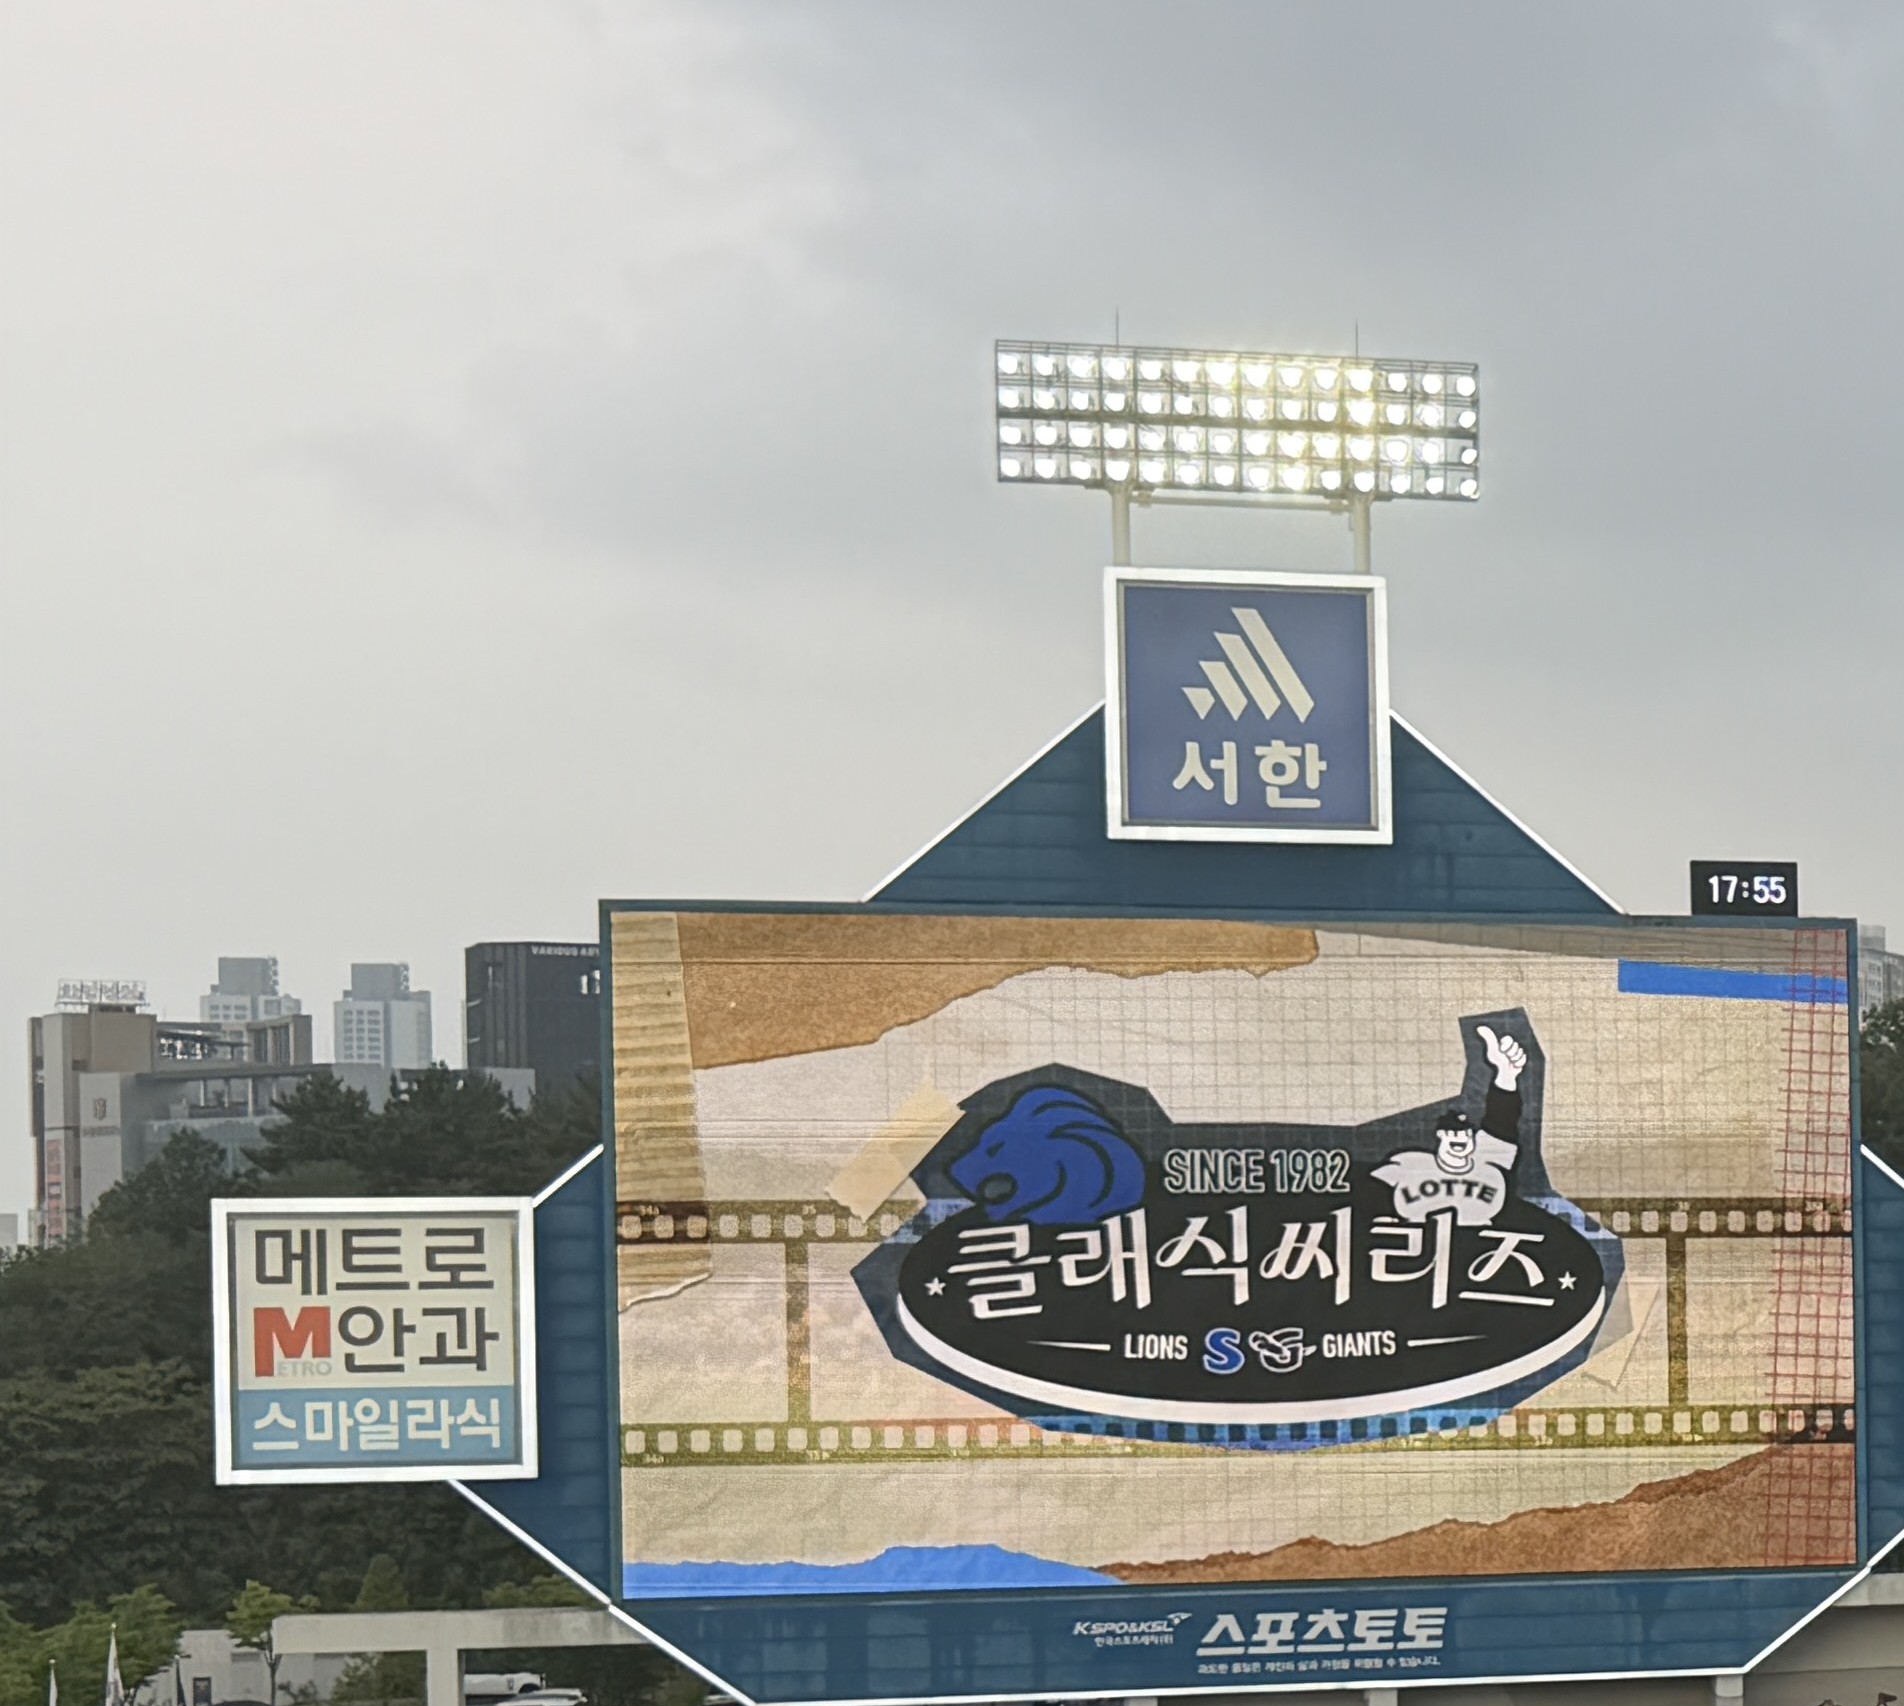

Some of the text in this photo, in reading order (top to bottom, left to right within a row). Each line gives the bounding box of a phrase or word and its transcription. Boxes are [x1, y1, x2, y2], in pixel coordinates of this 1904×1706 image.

[1171, 738, 1328, 810] 서한
[1707, 874, 1788, 905] 17:55
[1163, 1149, 1351, 1194] SINCE 1982
[1401, 1178, 1496, 1206] LOTTE
[255, 1228, 495, 1296] 메트로
[338, 1306, 500, 1373] 안과
[1124, 1334, 1188, 1360] LIONS
[1322, 1331, 1397, 1358] GIANTS
[252, 1398, 501, 1451] 스마일라식
[1196, 1607, 1448, 1657] 스포츠토토
